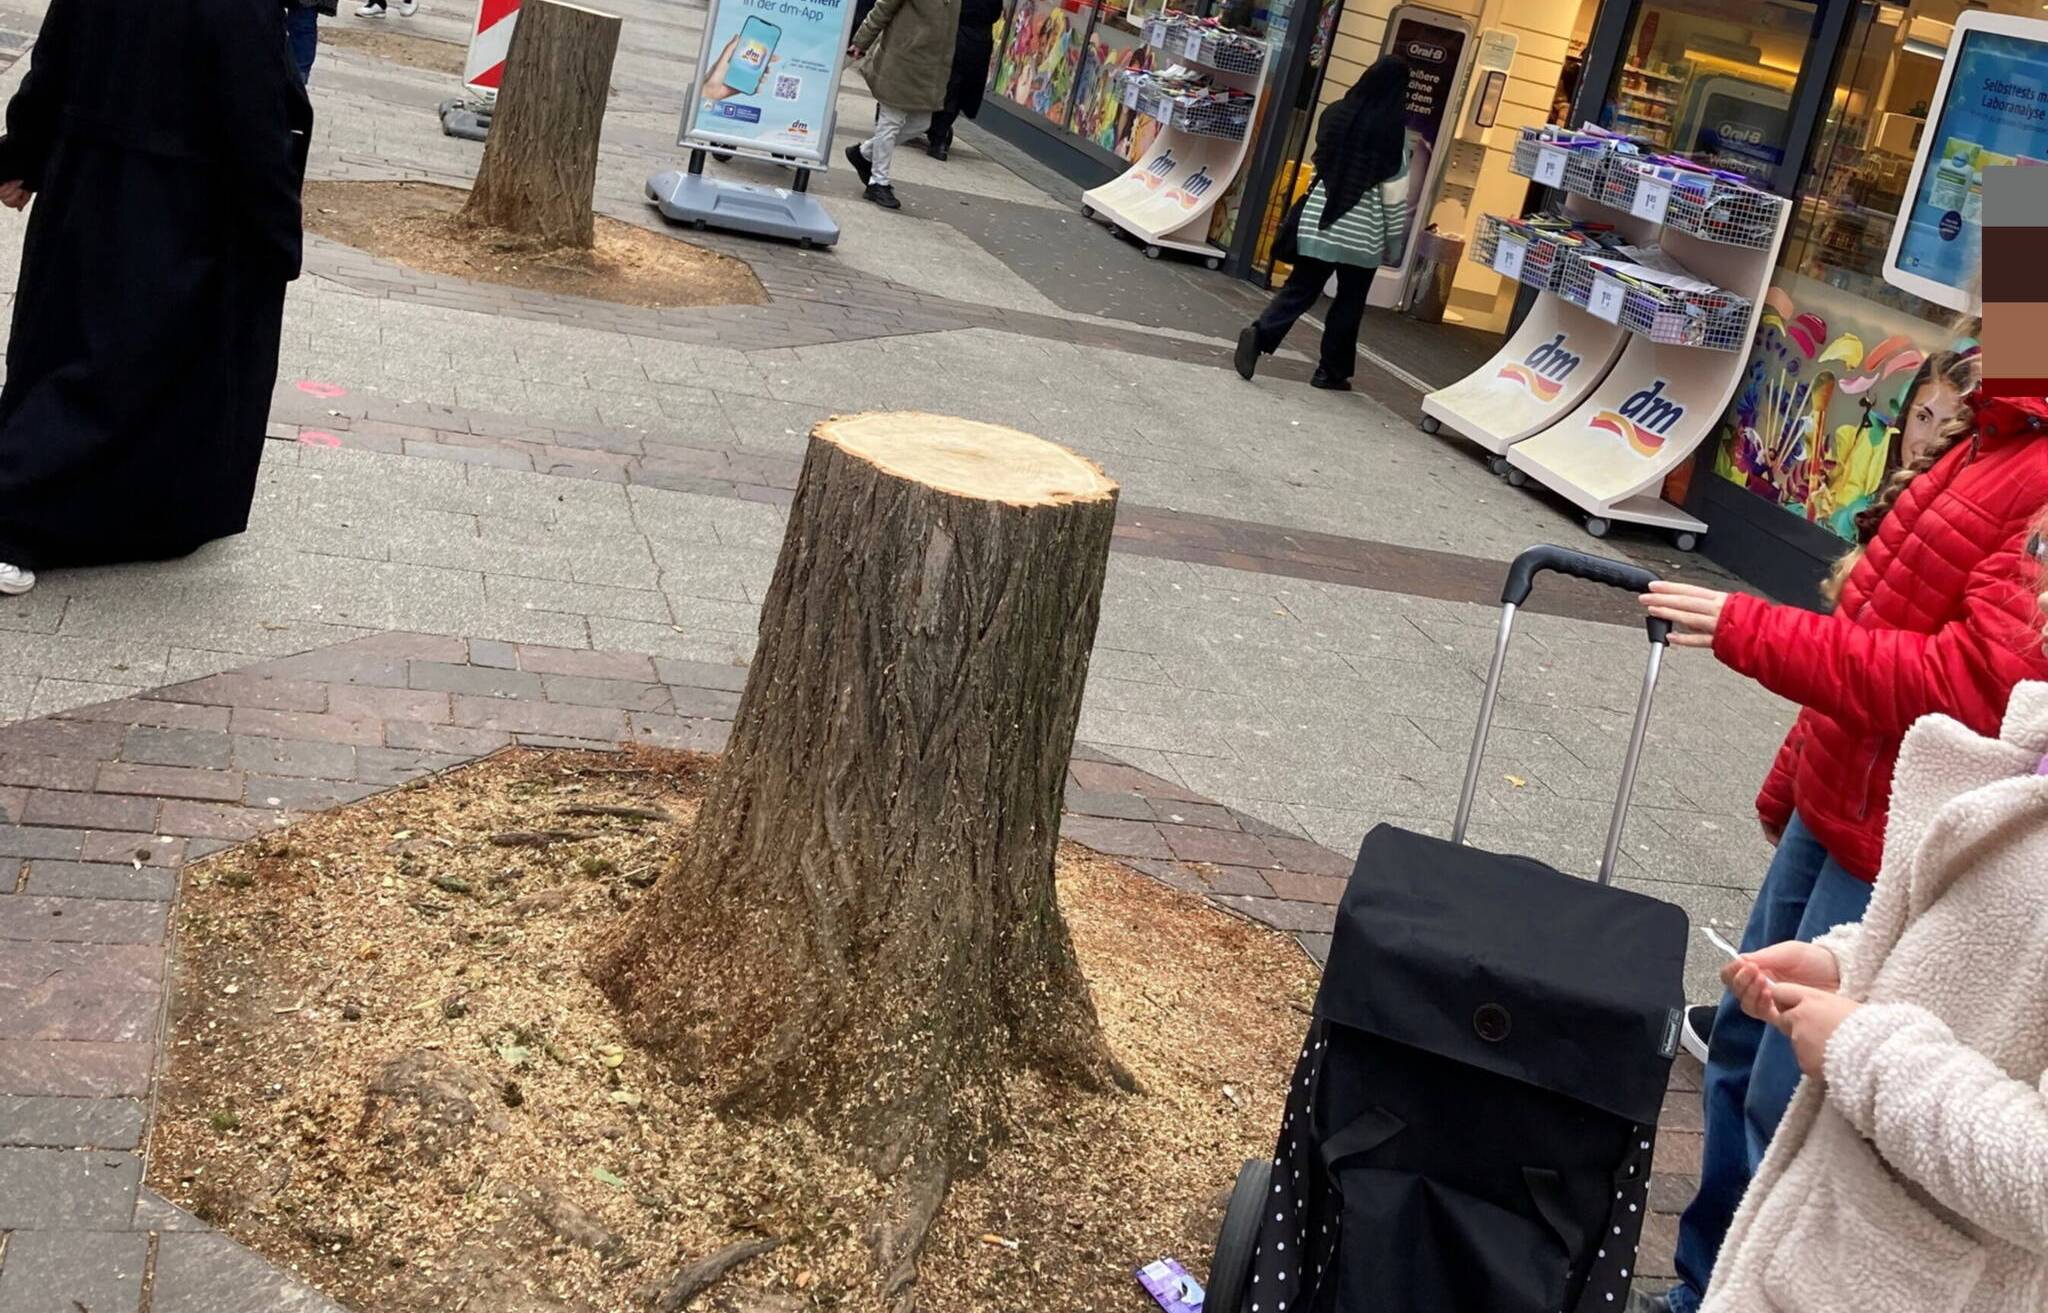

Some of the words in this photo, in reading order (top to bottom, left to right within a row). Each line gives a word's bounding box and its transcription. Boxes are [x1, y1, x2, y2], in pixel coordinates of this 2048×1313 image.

[757, 0, 777, 11] der
[779, 3, 824, 21] dm-App
[1409, 44, 1444, 60] Oral-B
[1983, 78, 2034, 100] Selbsttests
[1982, 95, 2046, 120] Laboranalyse
[791, 120, 808, 129] dm
[1146, 149, 1177, 177] dm
[1181, 166, 1213, 197] dm
[1524, 334, 1581, 382] dm
[1618, 380, 1684, 434] dm
